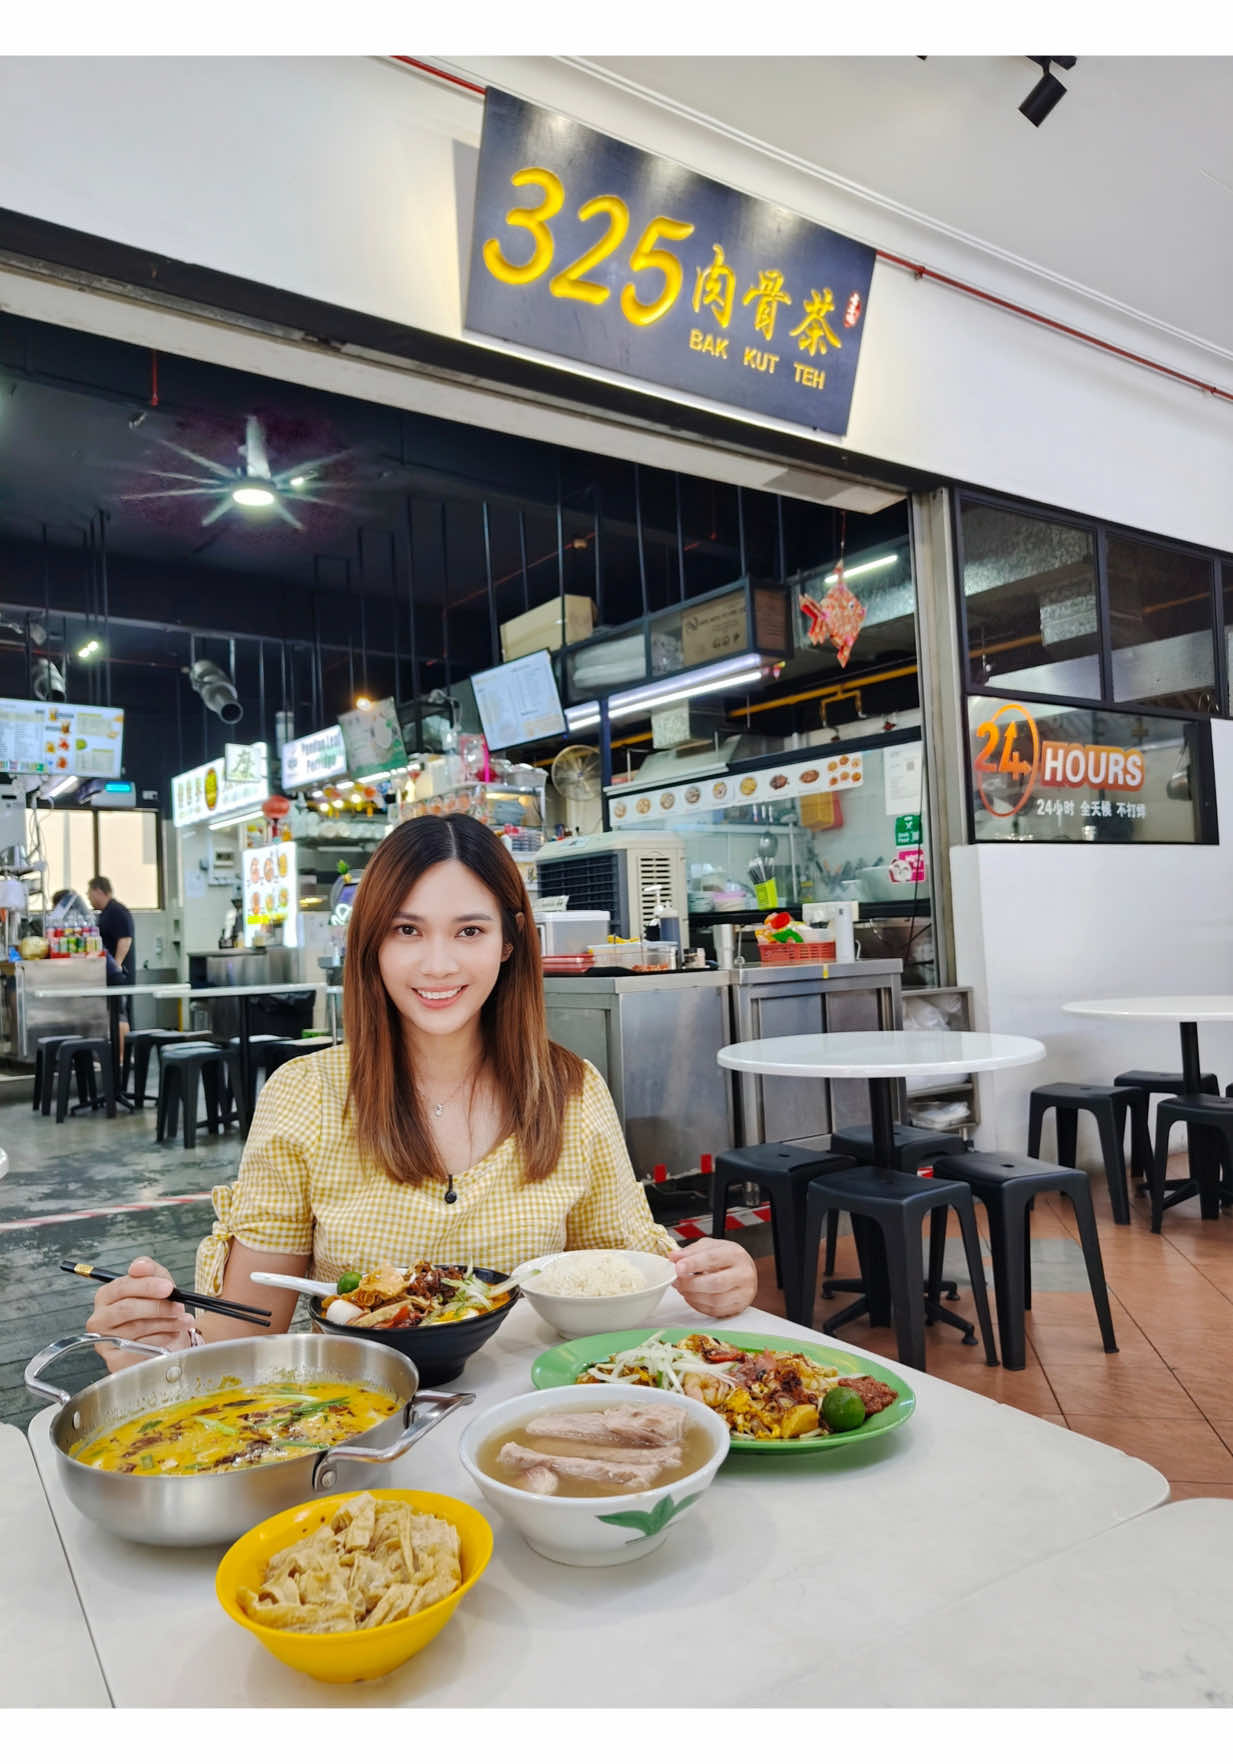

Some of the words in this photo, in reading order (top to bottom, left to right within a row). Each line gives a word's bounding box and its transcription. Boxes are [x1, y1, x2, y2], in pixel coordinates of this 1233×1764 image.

[483, 166, 695, 327] 325
[692, 244, 842, 356] 肉骨茶
[689, 329, 728, 359] BAK
[744, 347, 780, 375] KUT
[794, 362, 825, 390] TEH
[974, 720, 1032, 780] 24
[1045, 747, 1142, 786] HOURS
[1036, 798, 1074, 817] 24小时
